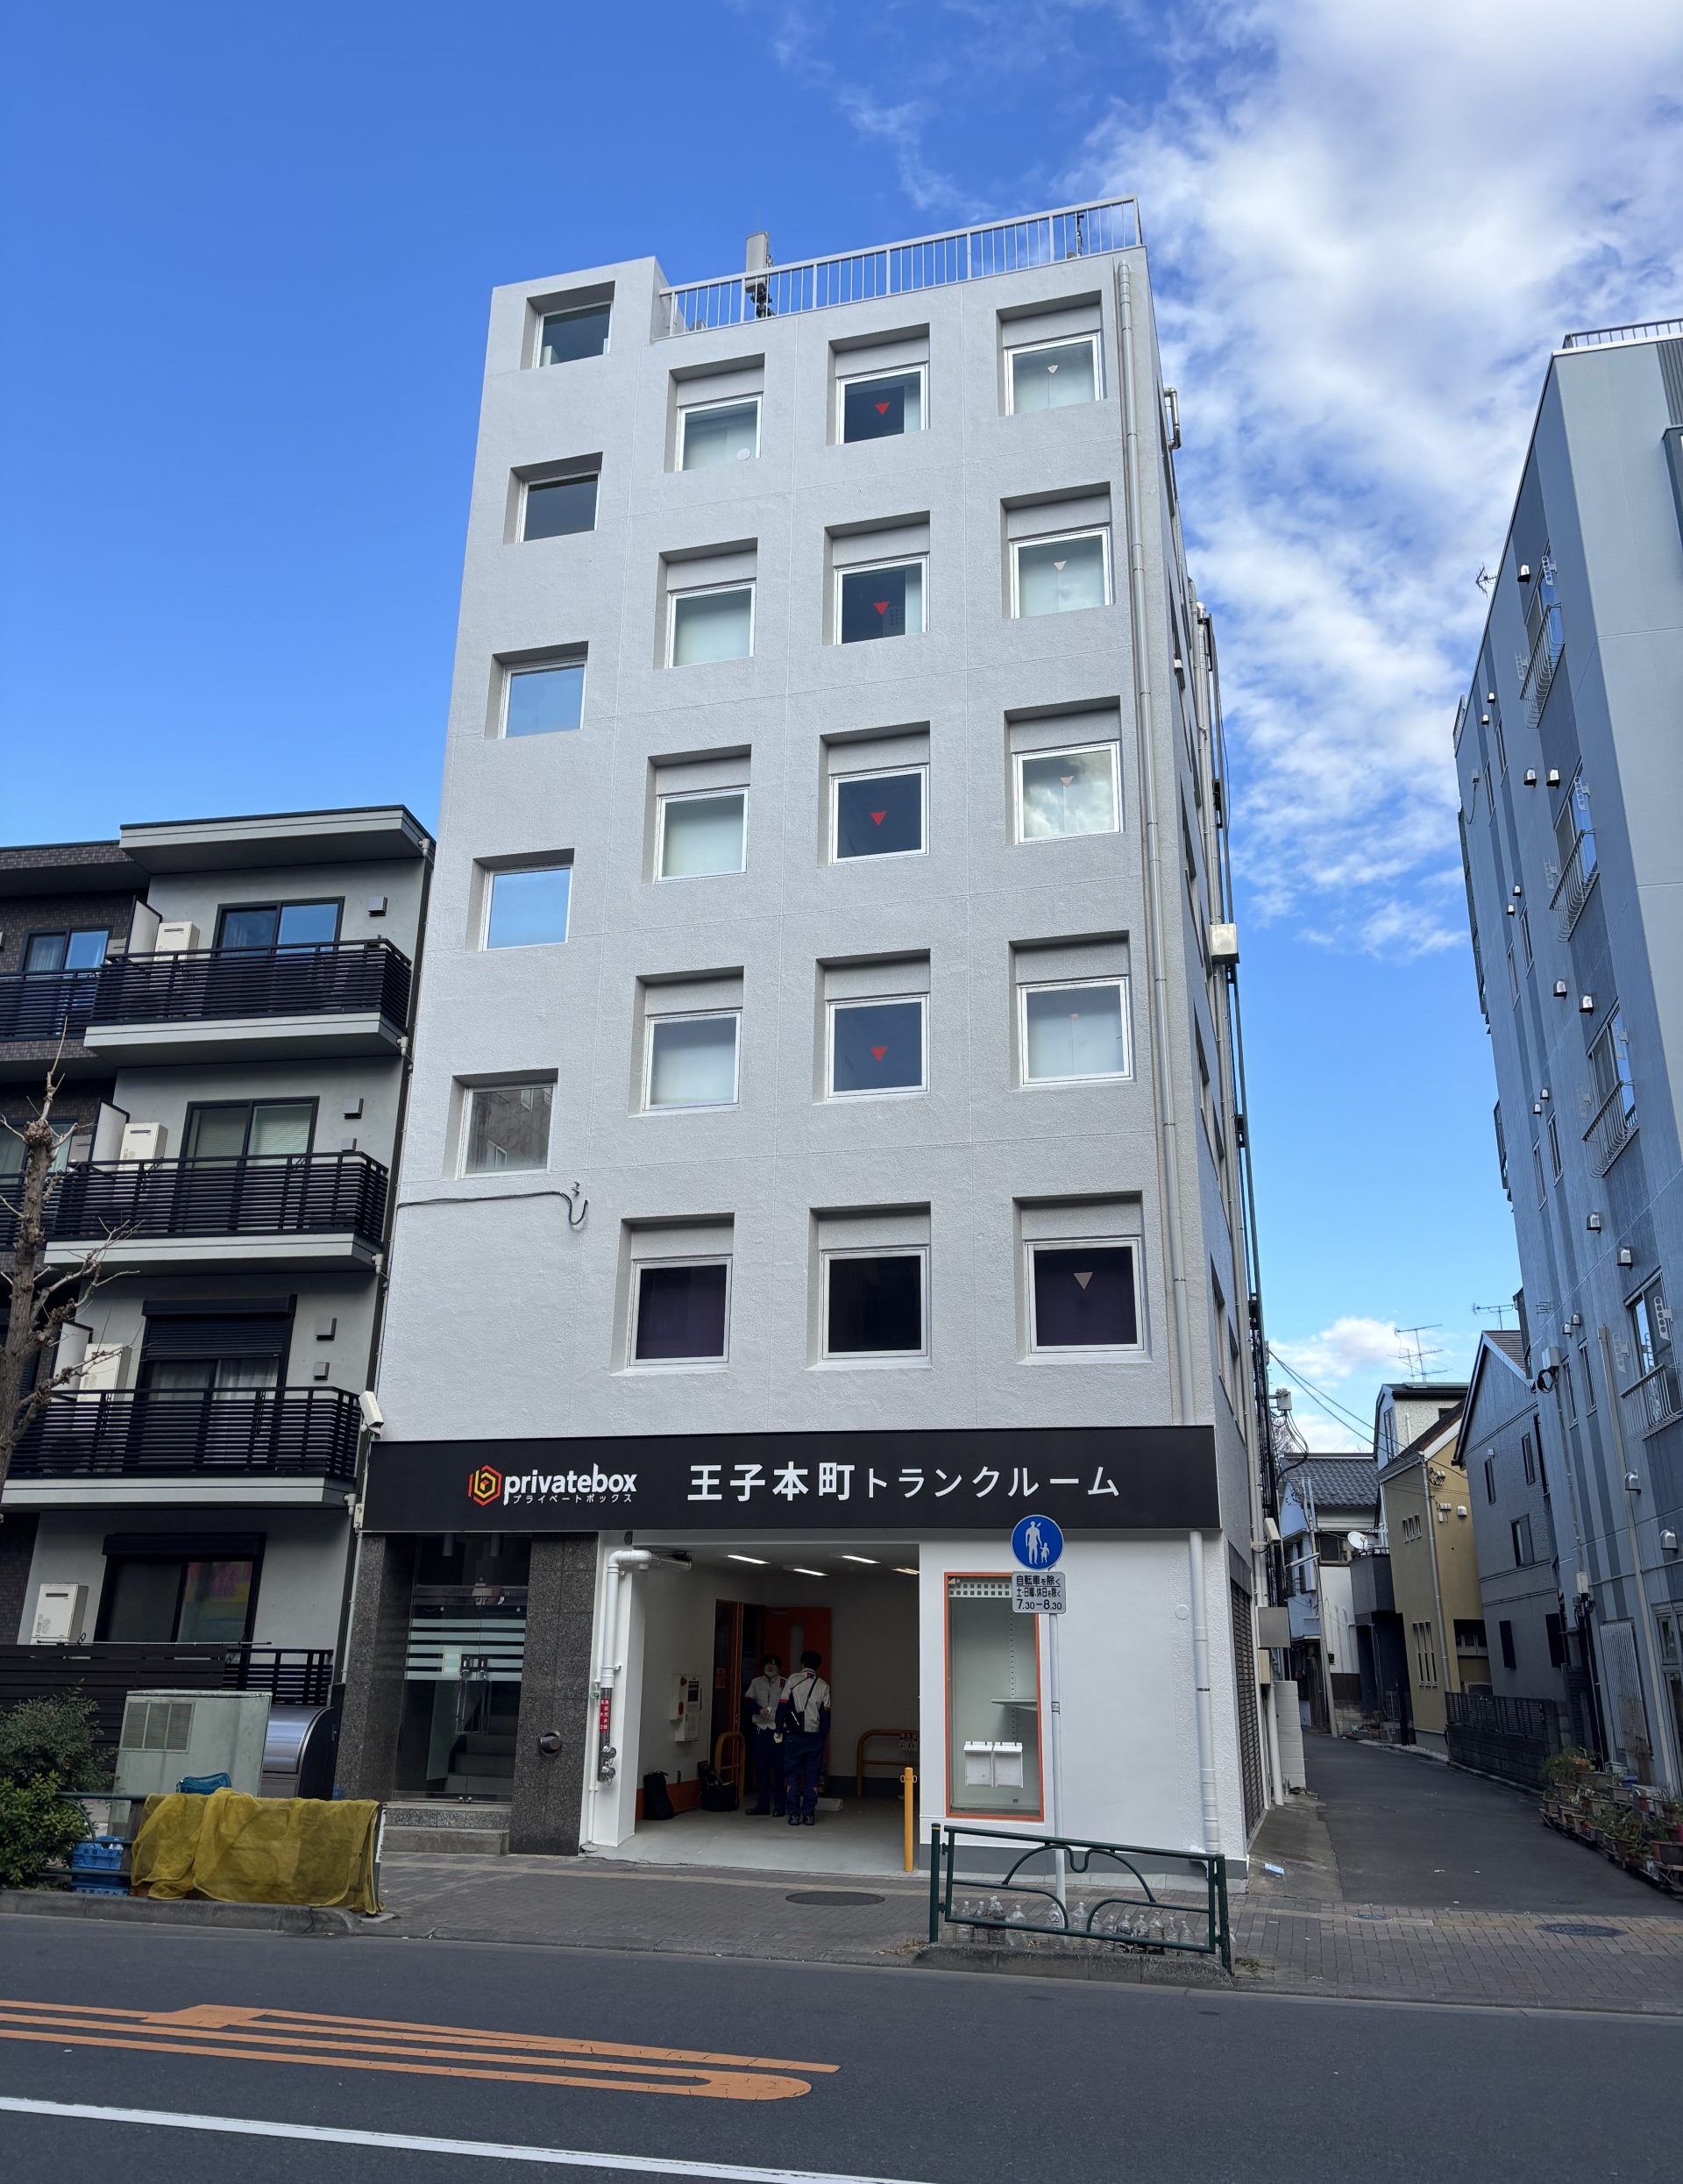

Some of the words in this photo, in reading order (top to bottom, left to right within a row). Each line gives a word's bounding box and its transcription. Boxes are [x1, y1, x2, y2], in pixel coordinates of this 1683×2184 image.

[503, 1462, 637, 1506] privatebox
[513, 1493, 632, 1505] プライベートボックス
[1016, 1575, 1061, 1586] 自転車を除く
